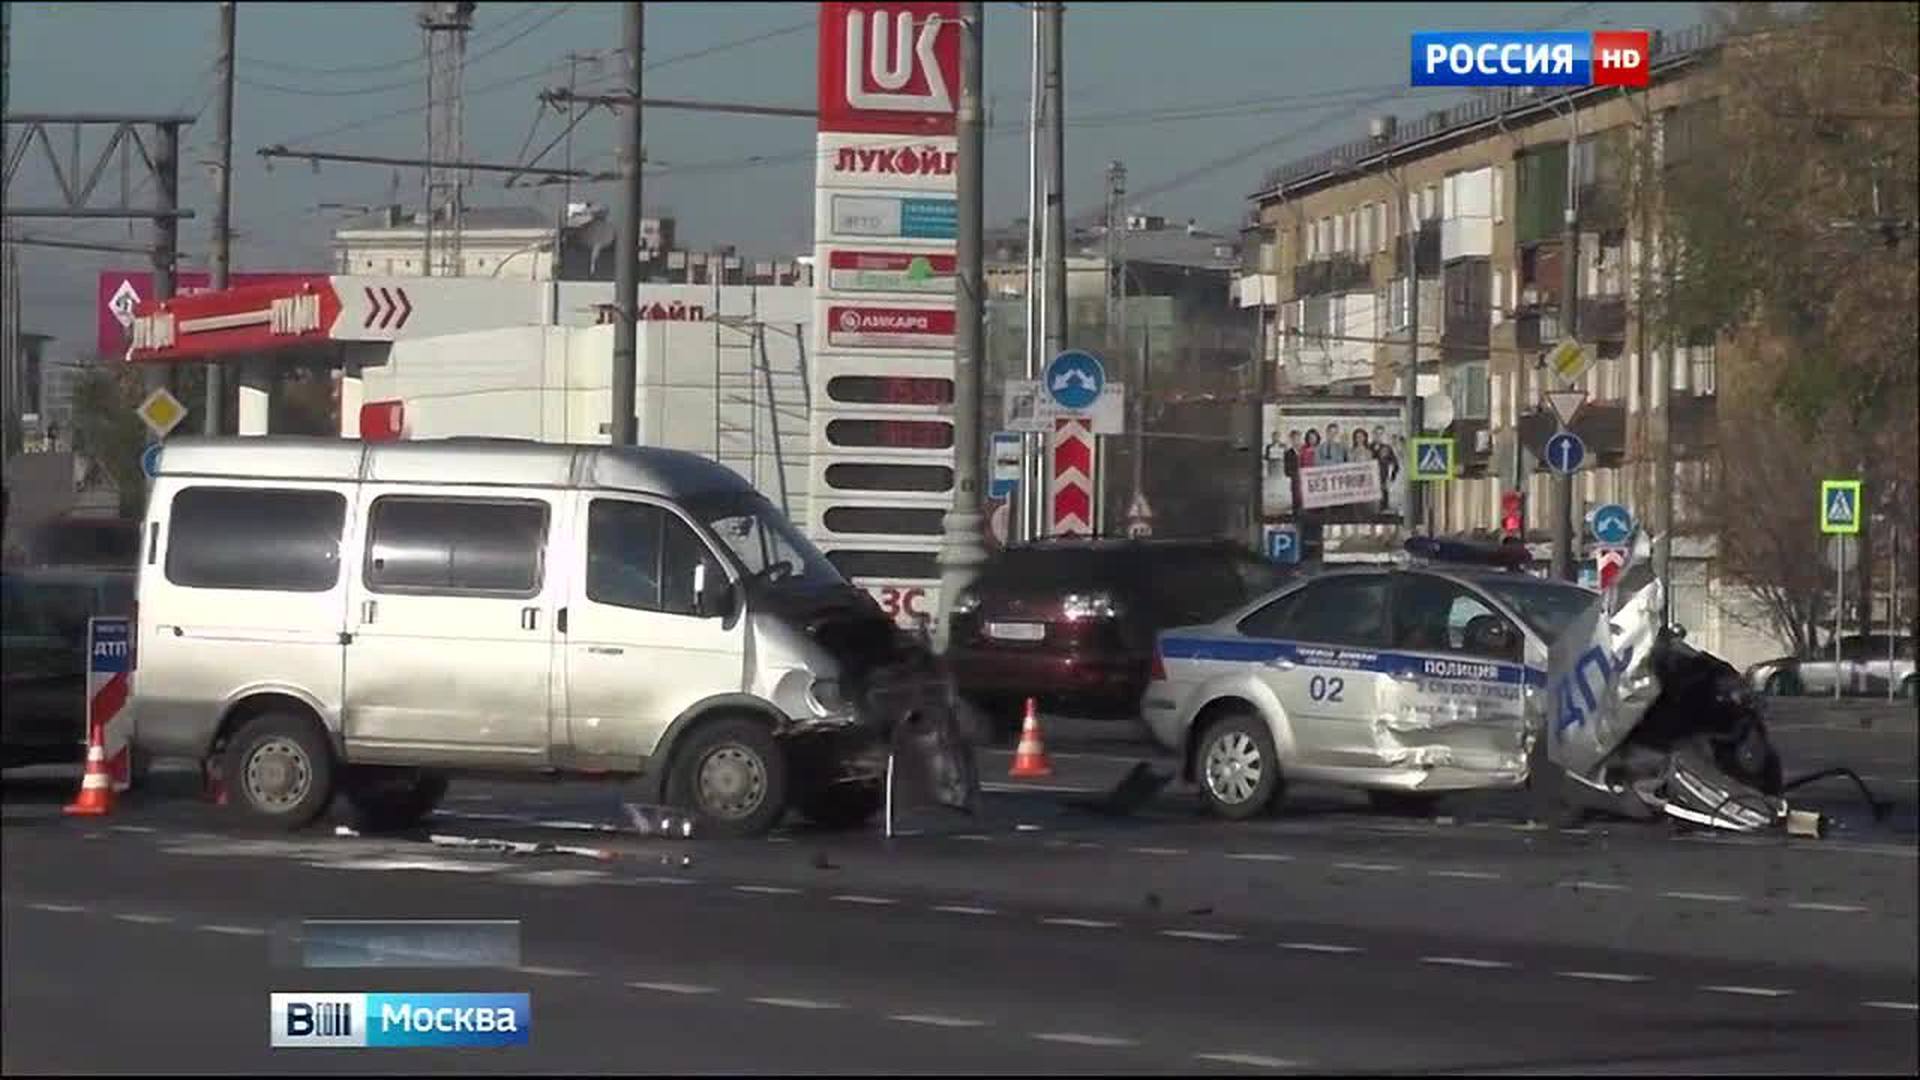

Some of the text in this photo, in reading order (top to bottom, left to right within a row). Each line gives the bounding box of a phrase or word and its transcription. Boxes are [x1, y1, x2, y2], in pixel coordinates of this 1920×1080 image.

[95, 640, 127, 657] ДТП
[1424, 660, 1499, 679] ПОЛИЦИЯ
[1310, 675, 1344, 702] 02
